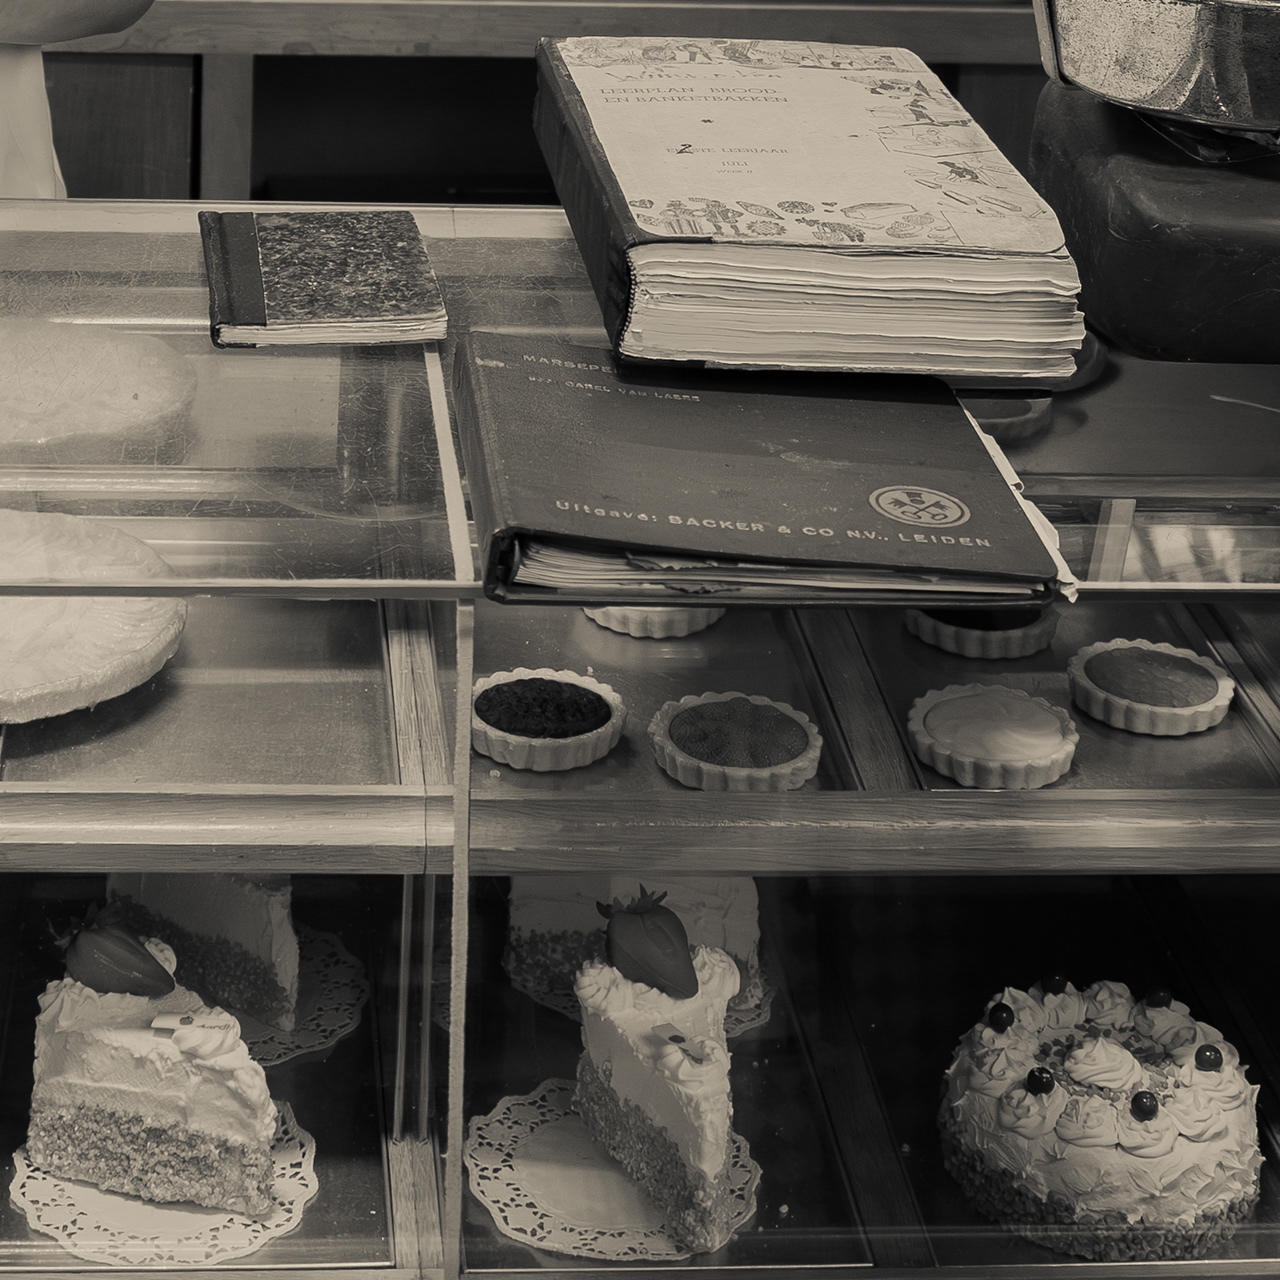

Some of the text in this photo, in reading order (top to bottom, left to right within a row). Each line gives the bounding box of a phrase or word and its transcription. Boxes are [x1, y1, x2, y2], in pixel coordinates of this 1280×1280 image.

[634, 96, 788, 104] BANKETBAKKEN
[522, 354, 617, 374] MARSEPE
[668, 515, 765, 533] BACKER
[777, 525, 791, 535] &
[802, 526, 835, 538] CO
[898, 533, 991, 547] LEIDEN
